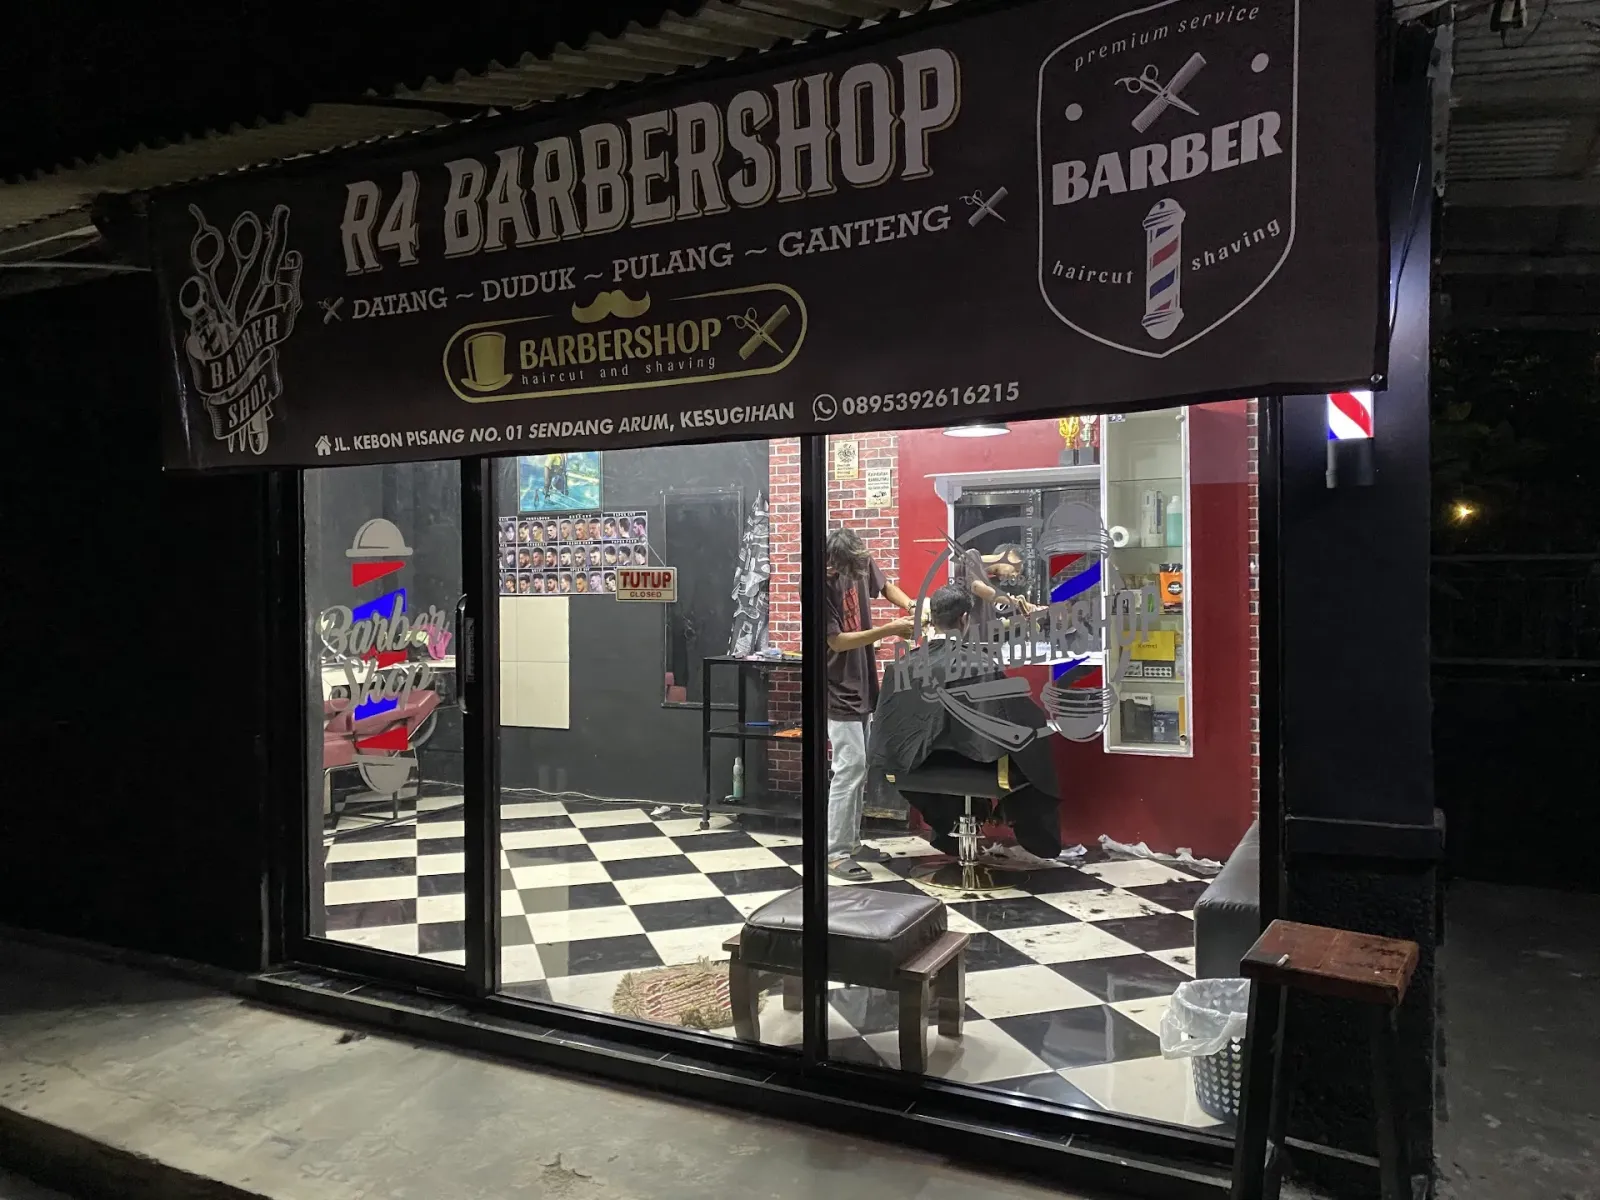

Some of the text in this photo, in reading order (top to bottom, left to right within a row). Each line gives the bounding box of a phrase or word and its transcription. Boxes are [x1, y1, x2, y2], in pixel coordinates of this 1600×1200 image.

[1074, 5, 1261, 71] premium service
[341, 47, 961, 276] R4 BARBERSHOP
[1052, 110, 1284, 206] BARBER
[352, 203, 952, 320] DATANG DUDUK PULANG GANTENG
[1052, 260, 1134, 285] haircut
[1191, 218, 1282, 271] shaving
[209, 313, 279, 390] BARBER
[519, 317, 723, 371] BARBERSHOP
[521, 355, 717, 386] haircut and shaving
[228, 374, 269, 429] SHOP
[334, 381, 1021, 452] JL. KEBON PISANG NO. 01 SENDANG ARUM, KESUGIHAN 0895392616215
[620, 571, 672, 588] TUTUP
[321, 595, 450, 658] Barber
[893, 584, 1160, 693] R4 BARBERSHOP
[330, 657, 435, 711] Shop
